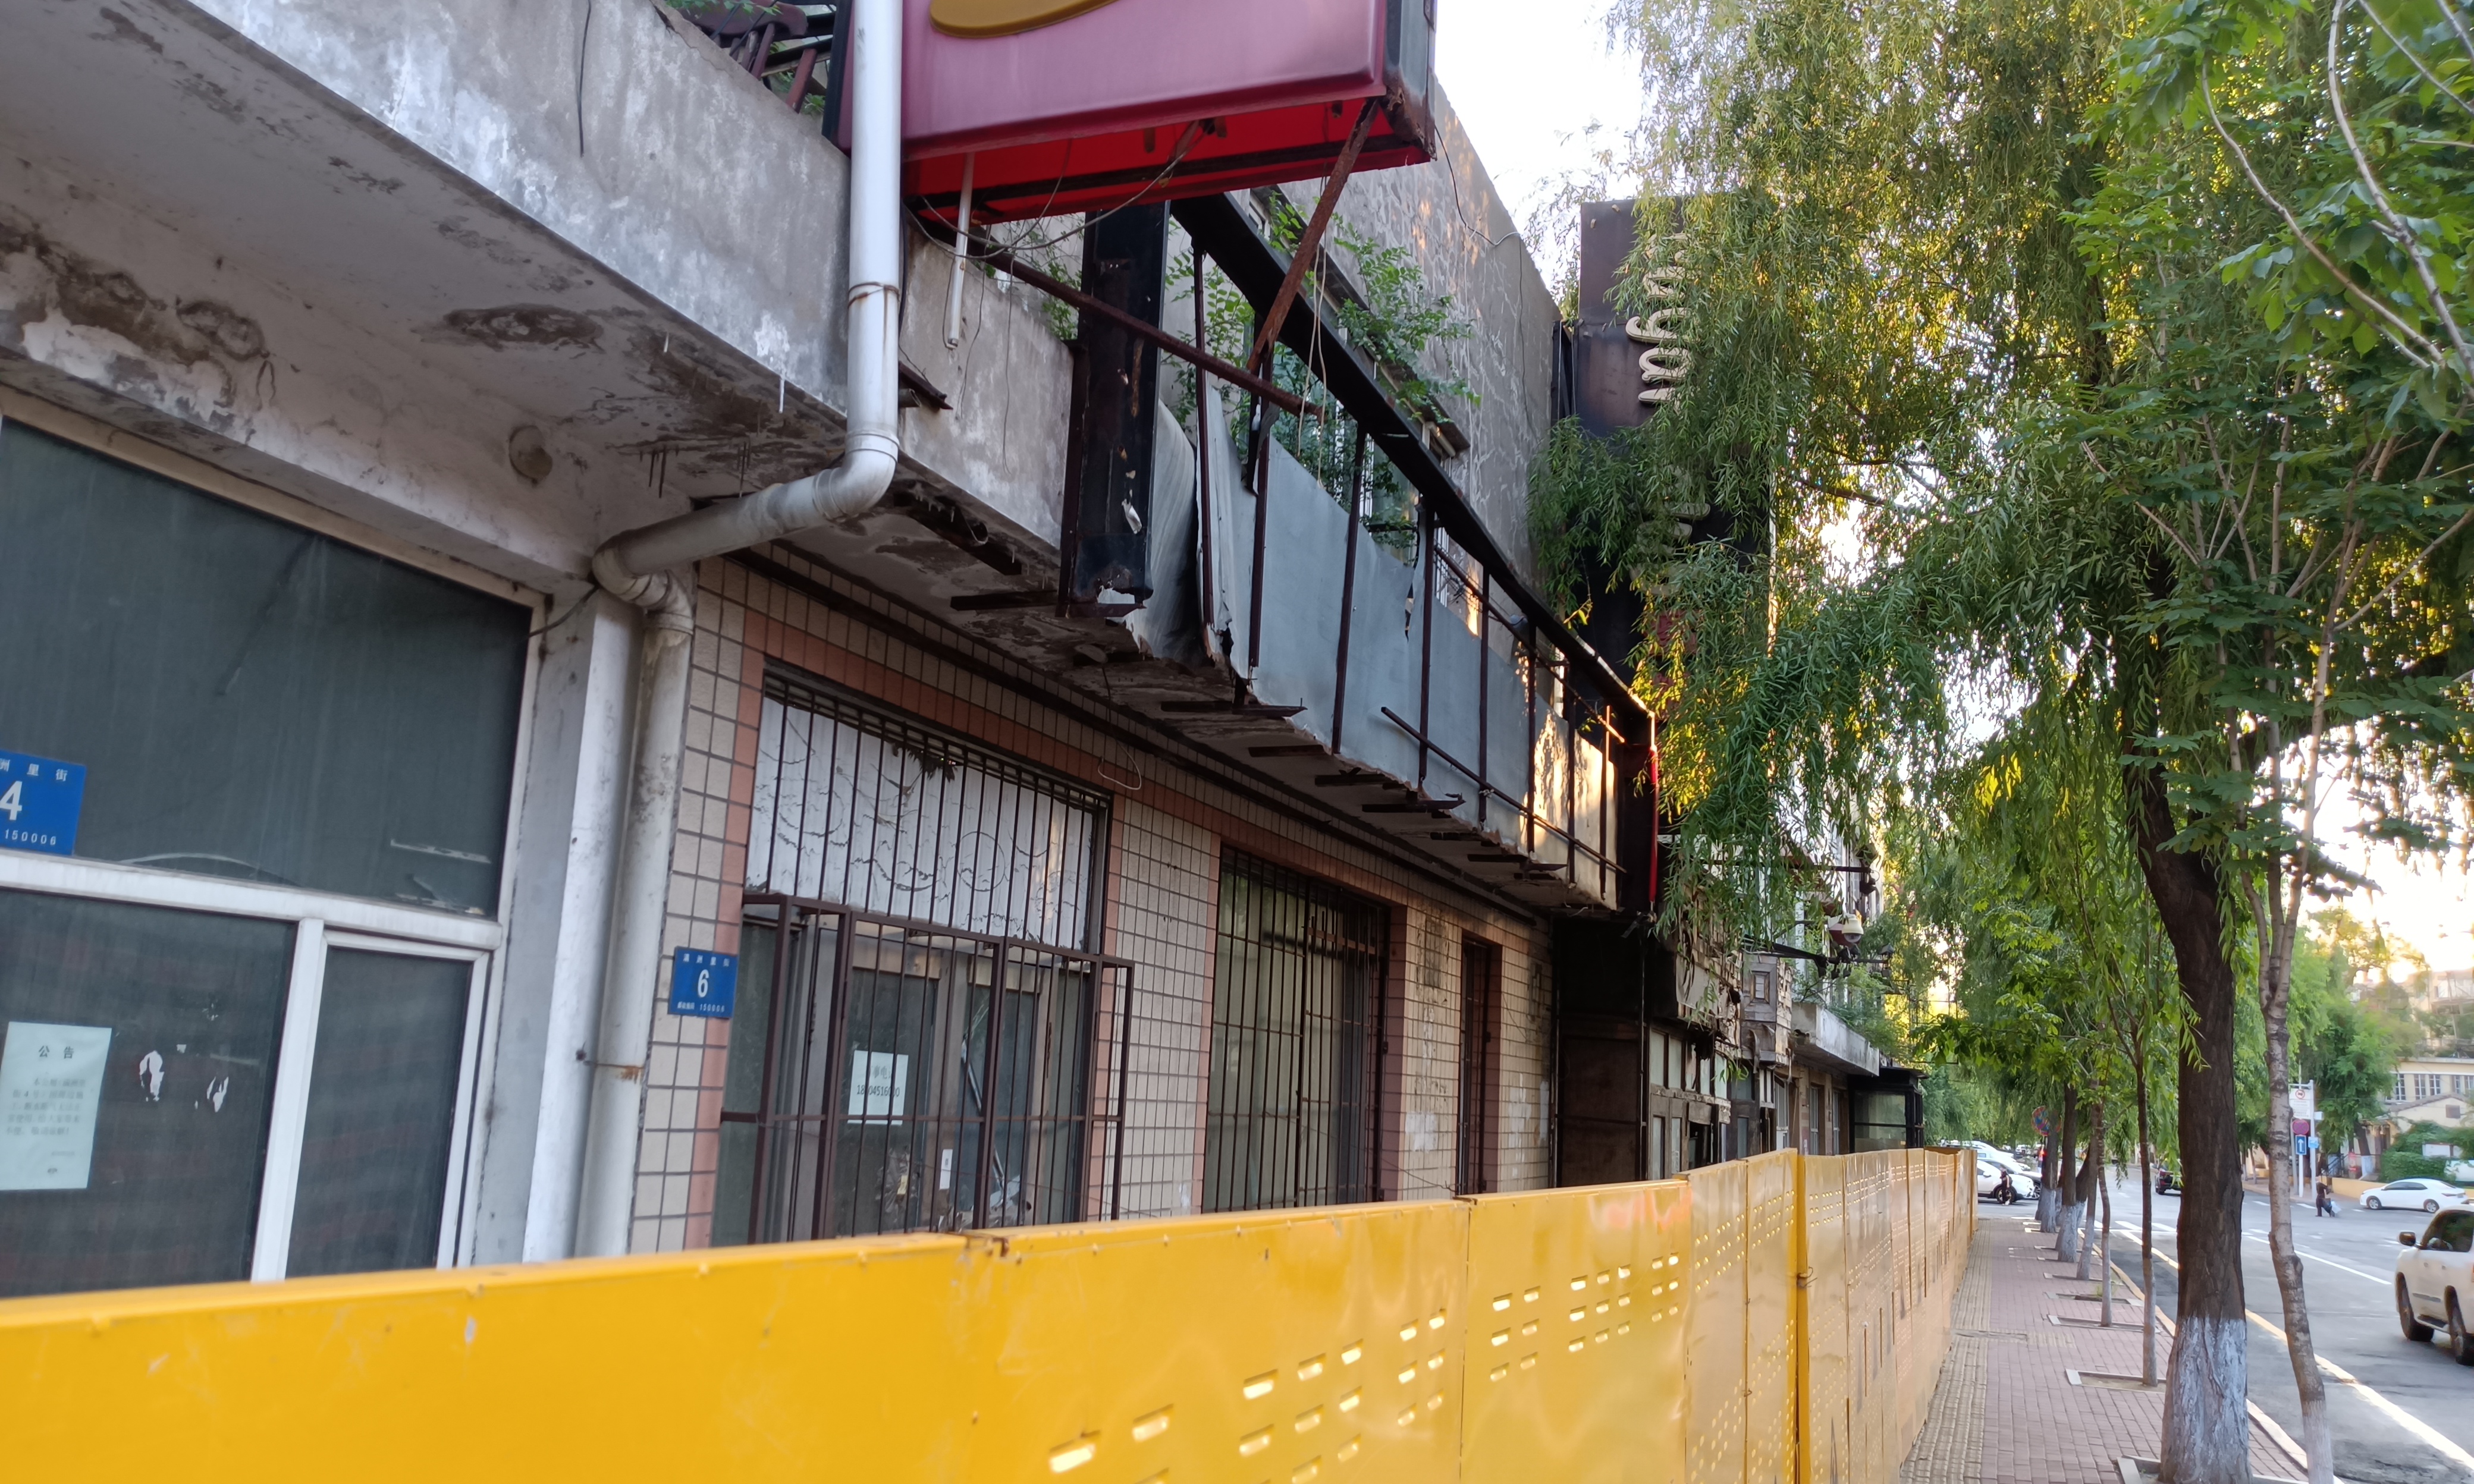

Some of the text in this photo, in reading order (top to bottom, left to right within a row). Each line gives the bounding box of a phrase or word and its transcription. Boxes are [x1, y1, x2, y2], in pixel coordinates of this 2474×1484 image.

[0, 781, 23, 821] 4
[4, 829, 57, 846] 150006
[698, 969, 709, 998] 6
[699, 1003, 725, 1013] 150006
[38, 1045, 75, 1059] 公告
